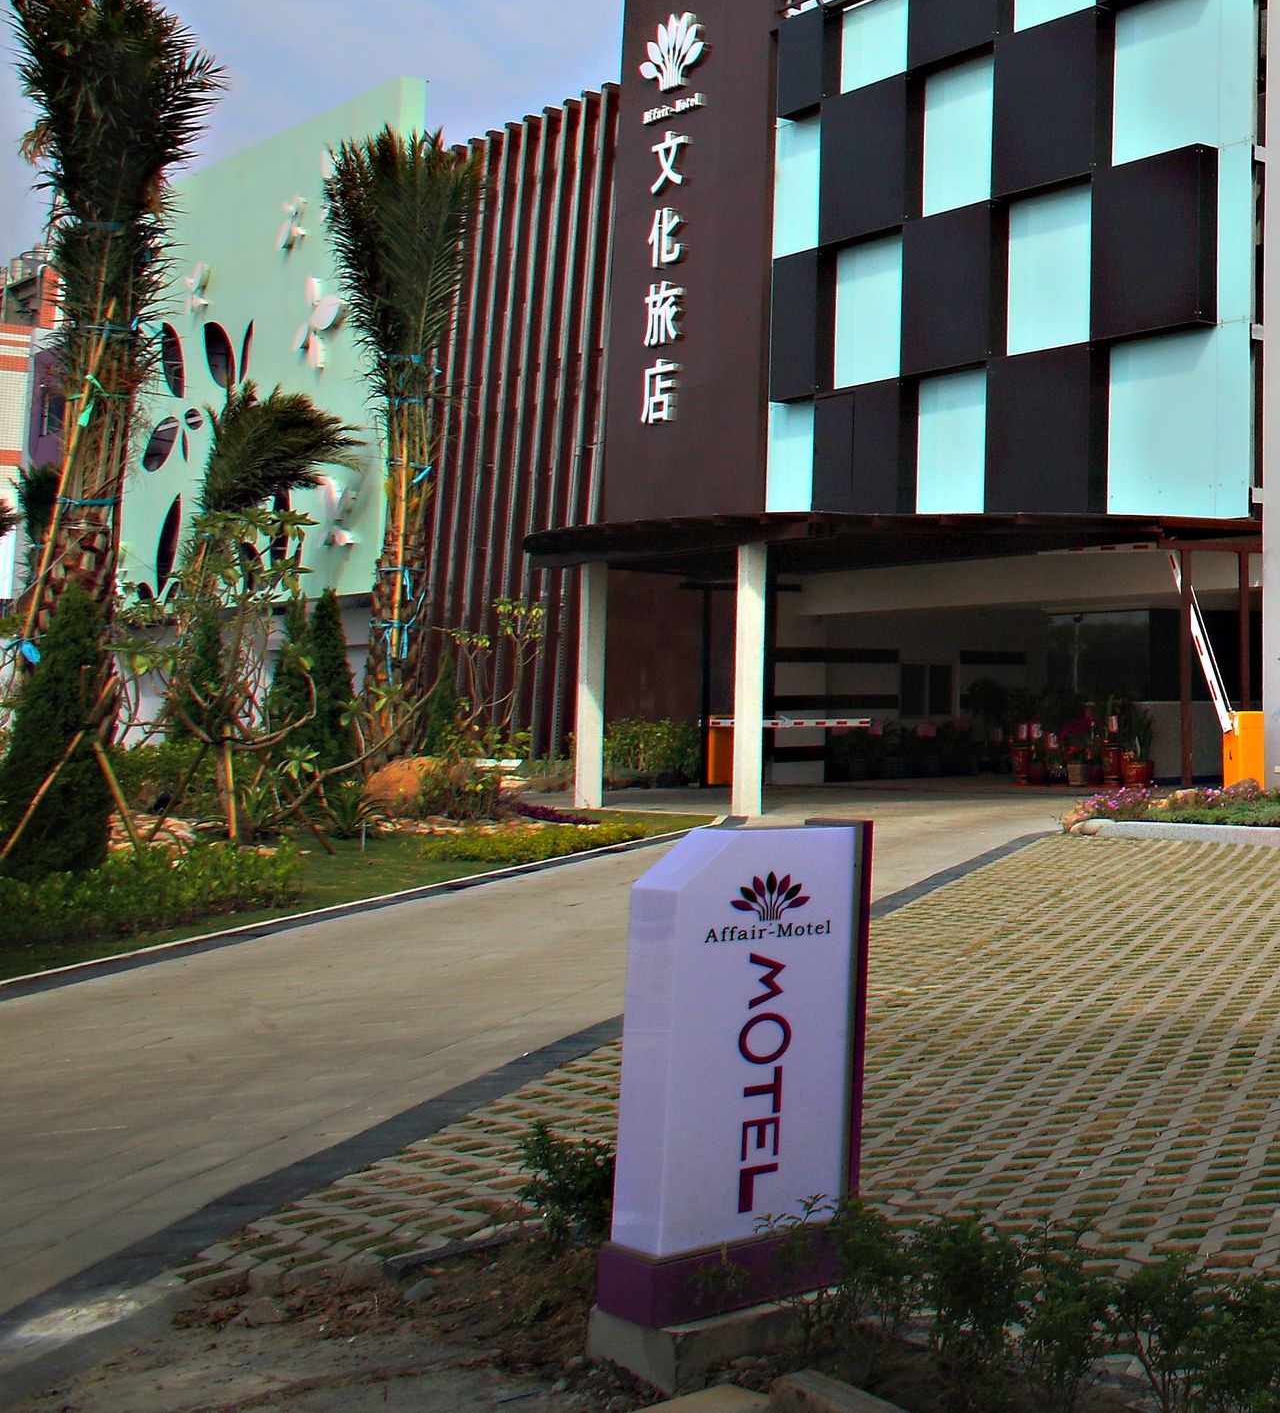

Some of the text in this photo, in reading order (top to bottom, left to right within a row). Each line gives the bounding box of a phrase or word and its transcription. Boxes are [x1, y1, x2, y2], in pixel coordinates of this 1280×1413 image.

[641, 130, 693, 424] 文化旅店
[704, 919, 832, 943] Affair-Motel
[738, 952, 792, 1214] MOTEL
